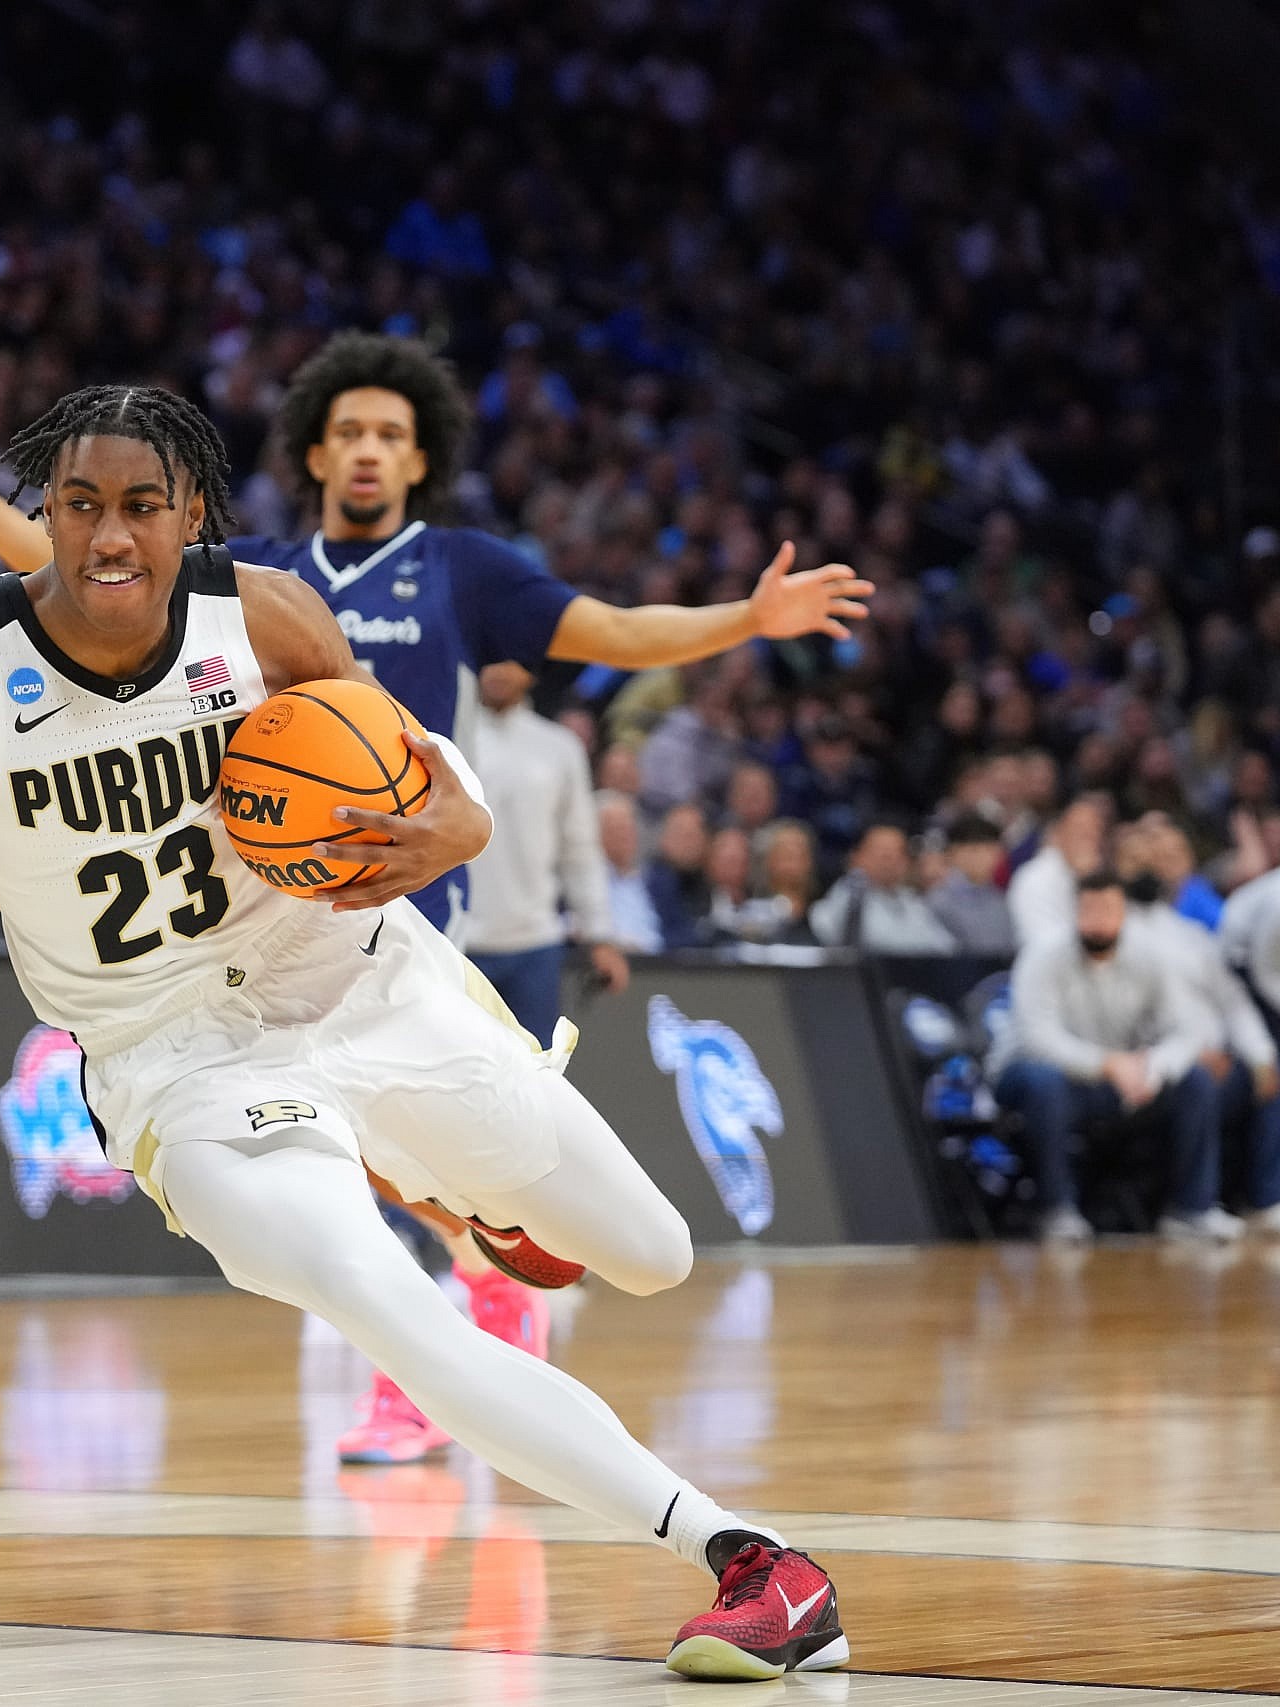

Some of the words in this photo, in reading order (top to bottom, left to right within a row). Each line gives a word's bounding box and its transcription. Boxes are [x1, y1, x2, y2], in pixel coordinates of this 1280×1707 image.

[13, 683, 42, 696] NCAA
[116, 684, 136, 698] P
[7, 715, 248, 836] PURDU
[74, 822, 233, 967] 23
